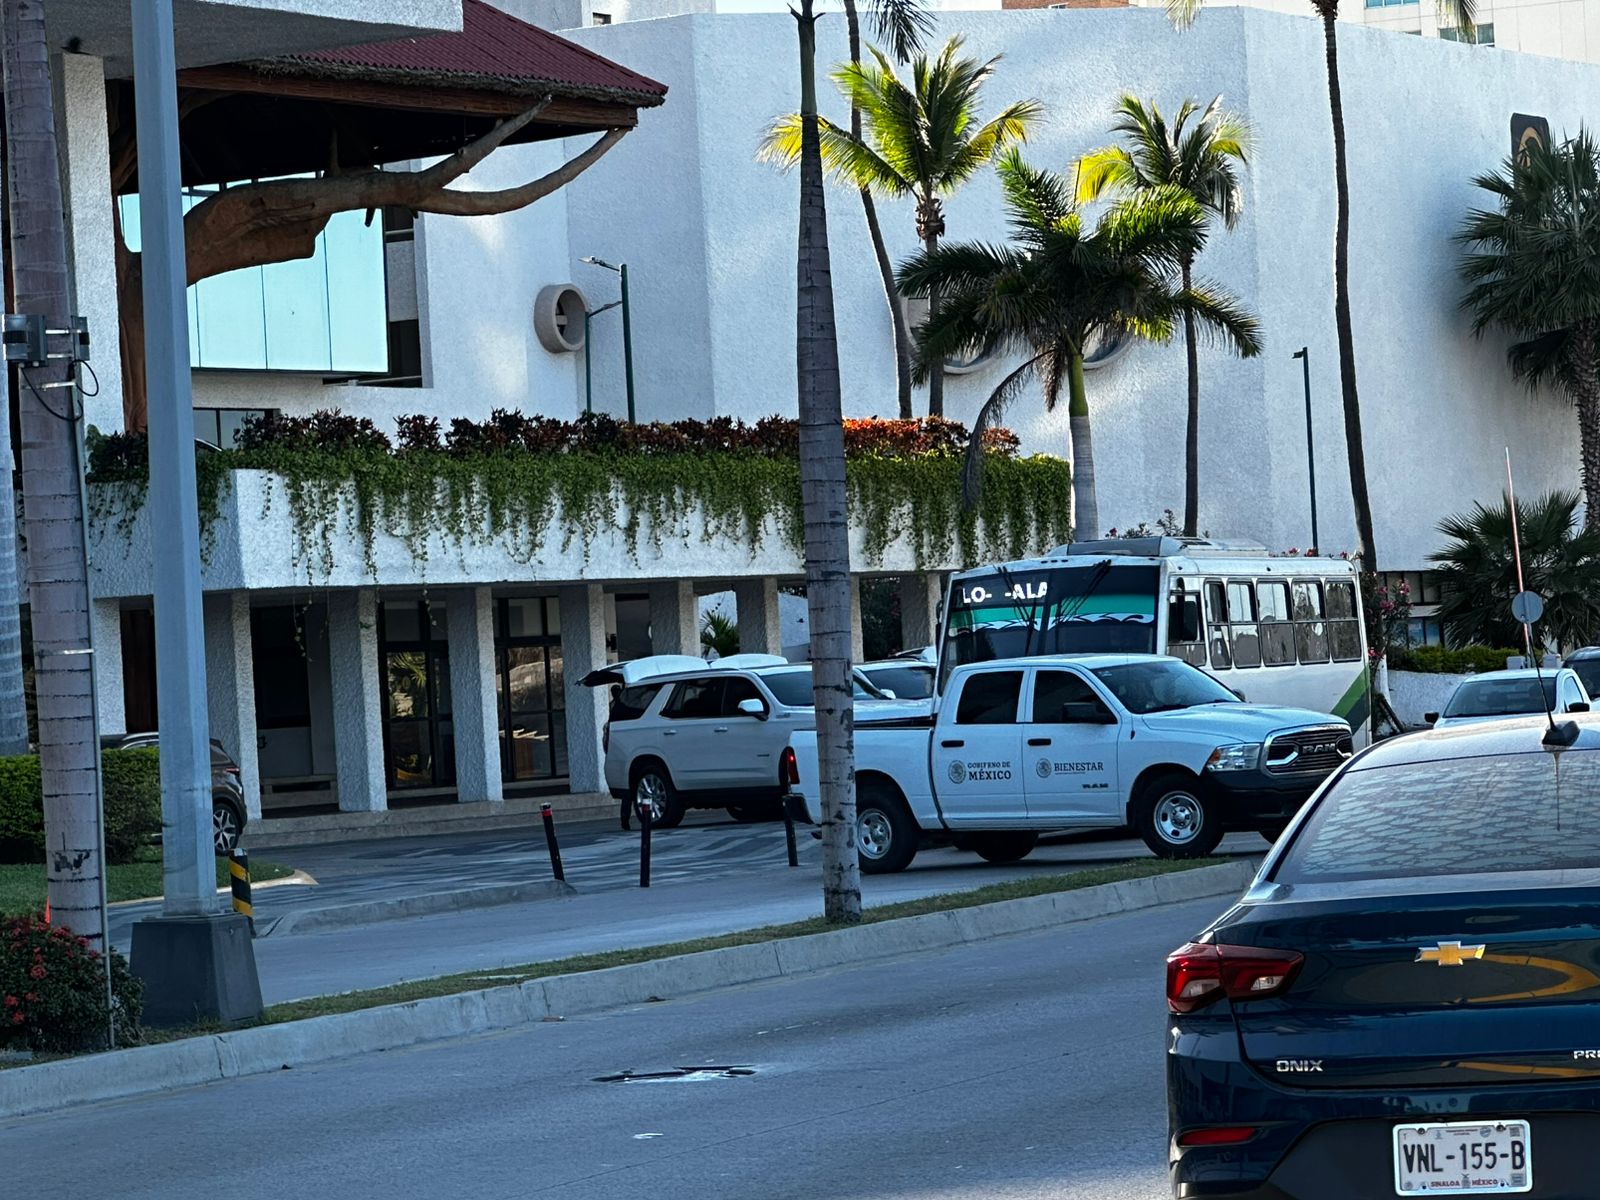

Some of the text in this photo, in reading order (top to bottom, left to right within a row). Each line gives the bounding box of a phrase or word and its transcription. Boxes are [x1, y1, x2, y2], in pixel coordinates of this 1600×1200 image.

[1302, 743, 1336, 754] RAM
[1054, 762, 1104, 771] BIENESTAR
[968, 768, 1012, 781] MÉXICO
[1276, 1060, 1324, 1072] ONIX
[1403, 1141, 1525, 1173] VNL-155-B
[1471, 1178, 1499, 1186] MÉXICO
